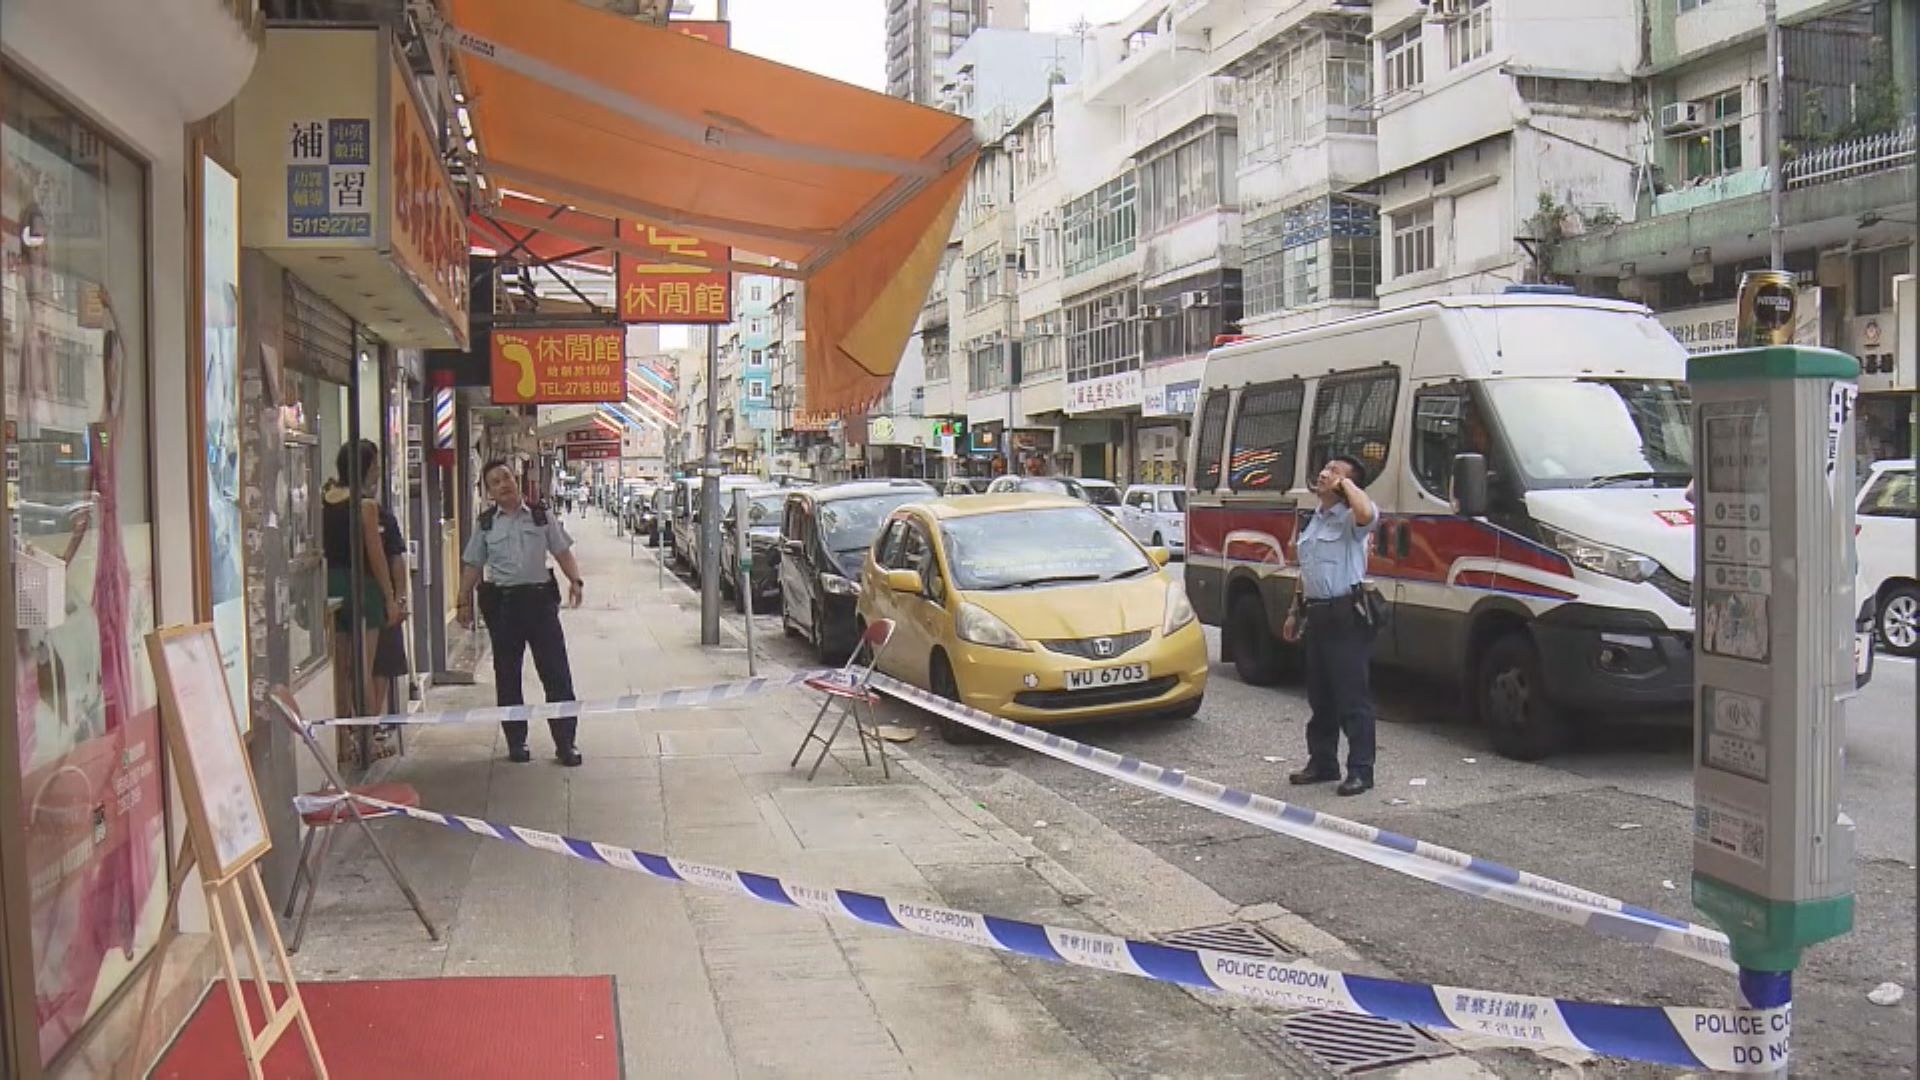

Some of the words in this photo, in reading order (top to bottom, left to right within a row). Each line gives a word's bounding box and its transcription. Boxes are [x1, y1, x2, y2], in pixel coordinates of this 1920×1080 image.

[288, 121, 323, 159] 補
[333, 170, 365, 207] 習
[292, 217, 368, 234] 51192712
[1071, 670, 1094, 688] WU
[1101, 665, 1144, 684] 6703
[900, 903, 931, 921] POLICE
[934, 908, 975, 929] CORDON
[1217, 958, 1265, 979] POLICE
[1694, 1014, 1766, 1035] POLICE
[1733, 1045, 1763, 1064] DO
